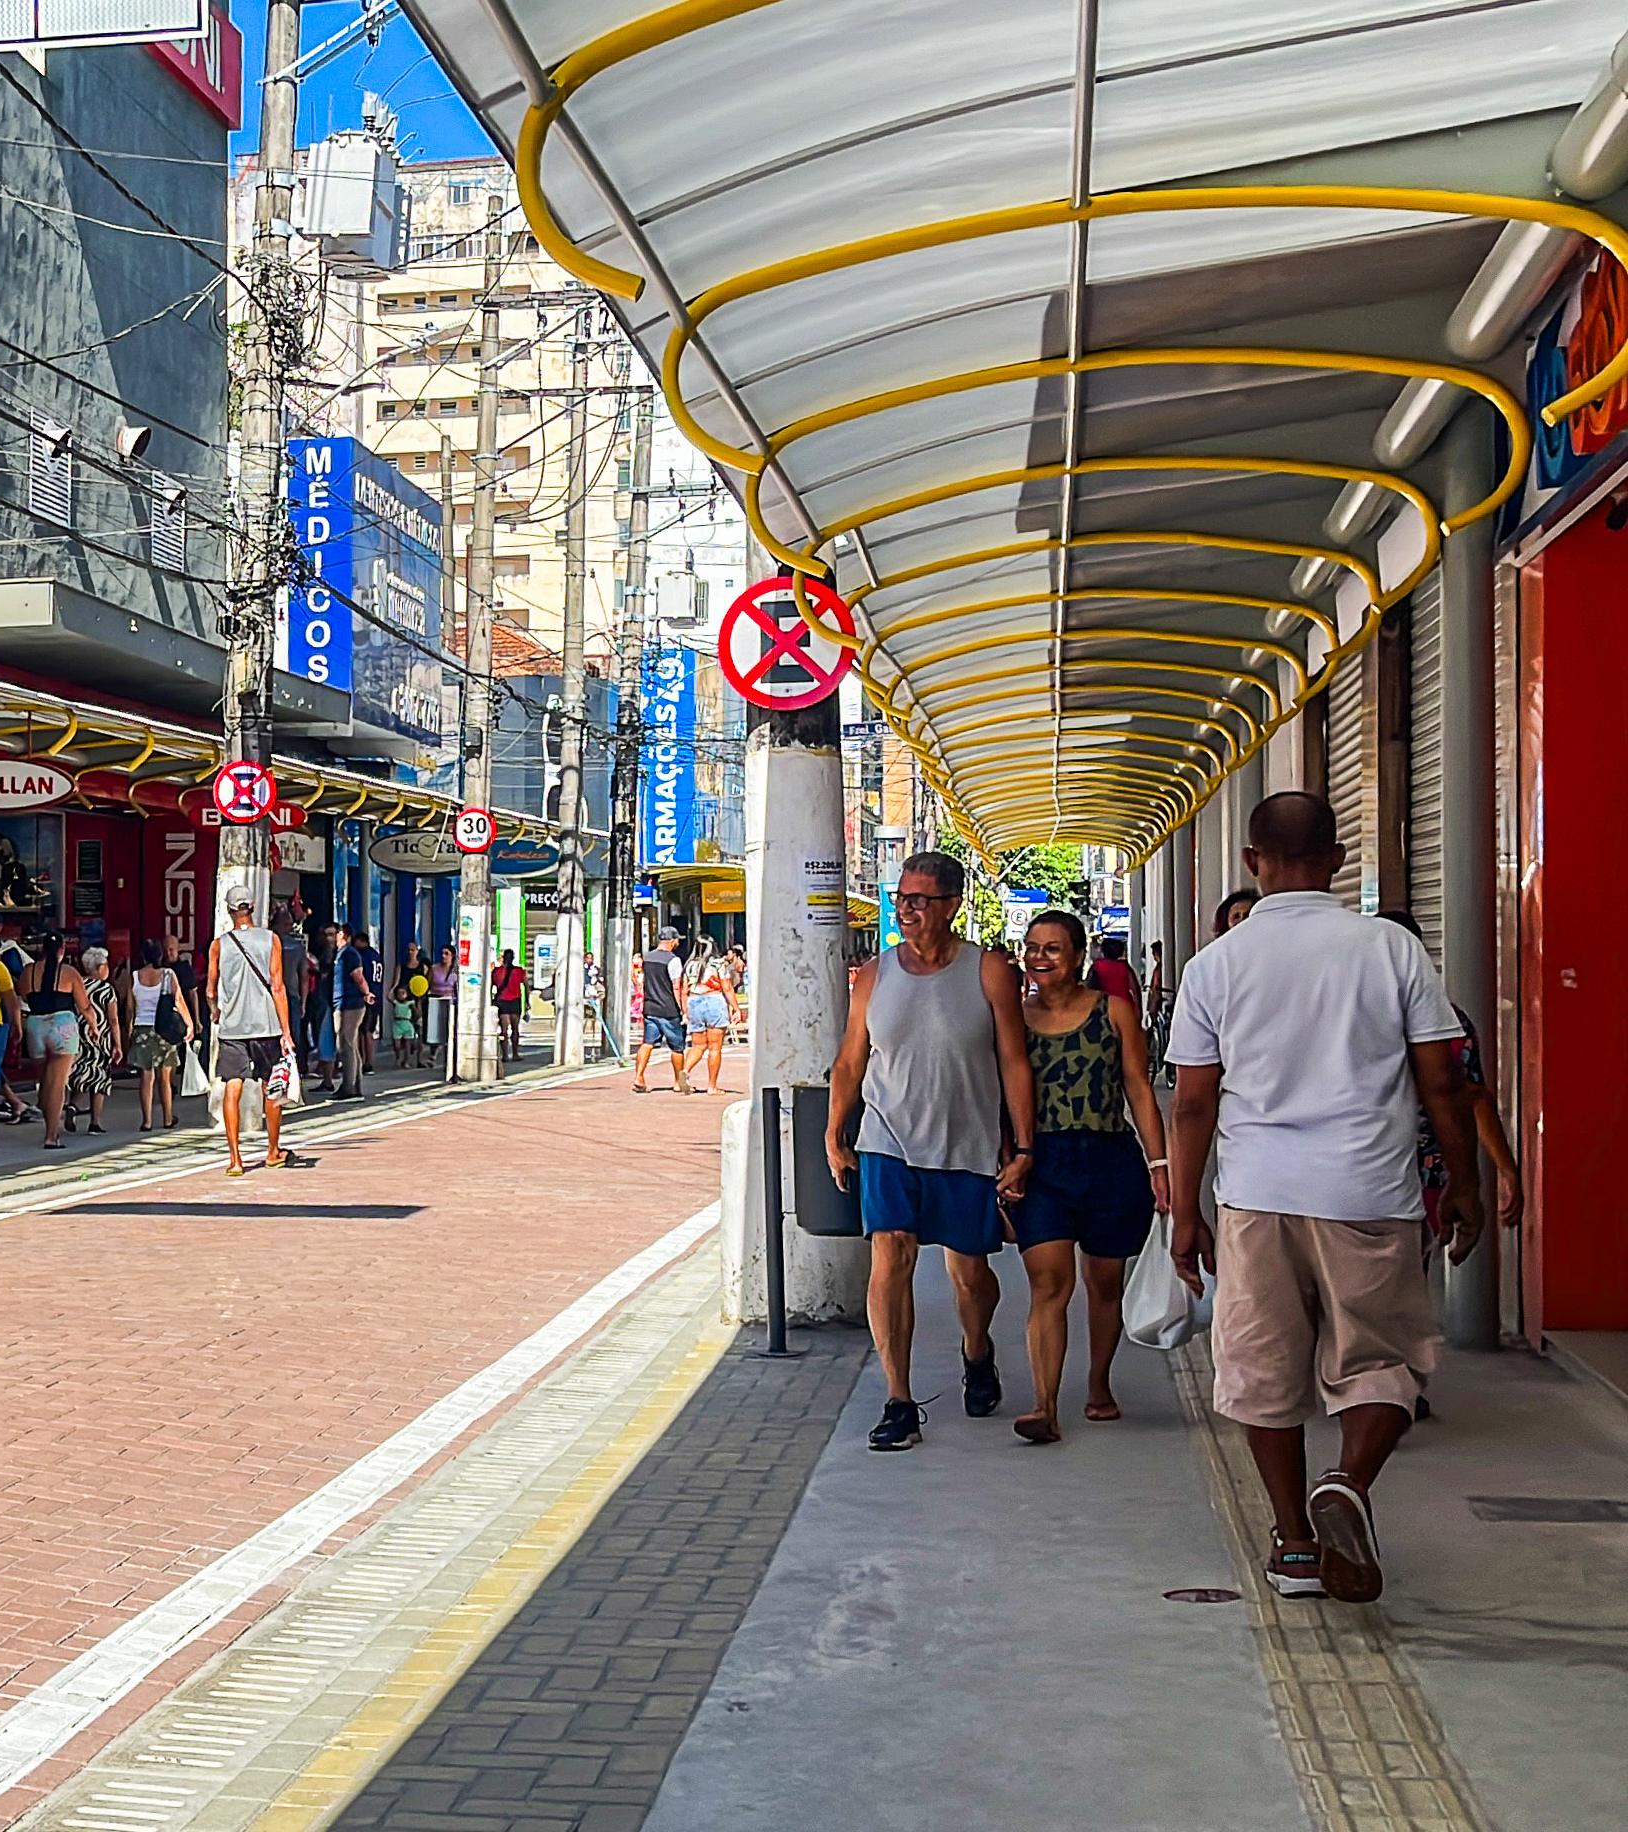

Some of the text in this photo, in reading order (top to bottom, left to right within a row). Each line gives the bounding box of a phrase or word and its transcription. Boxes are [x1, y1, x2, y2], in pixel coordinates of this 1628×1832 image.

[305, 446, 332, 684] MÉDICOS
[391, 839, 418, 854] Tic
[463, 817, 487, 834] 30
[164, 833, 195, 967] ESNI
